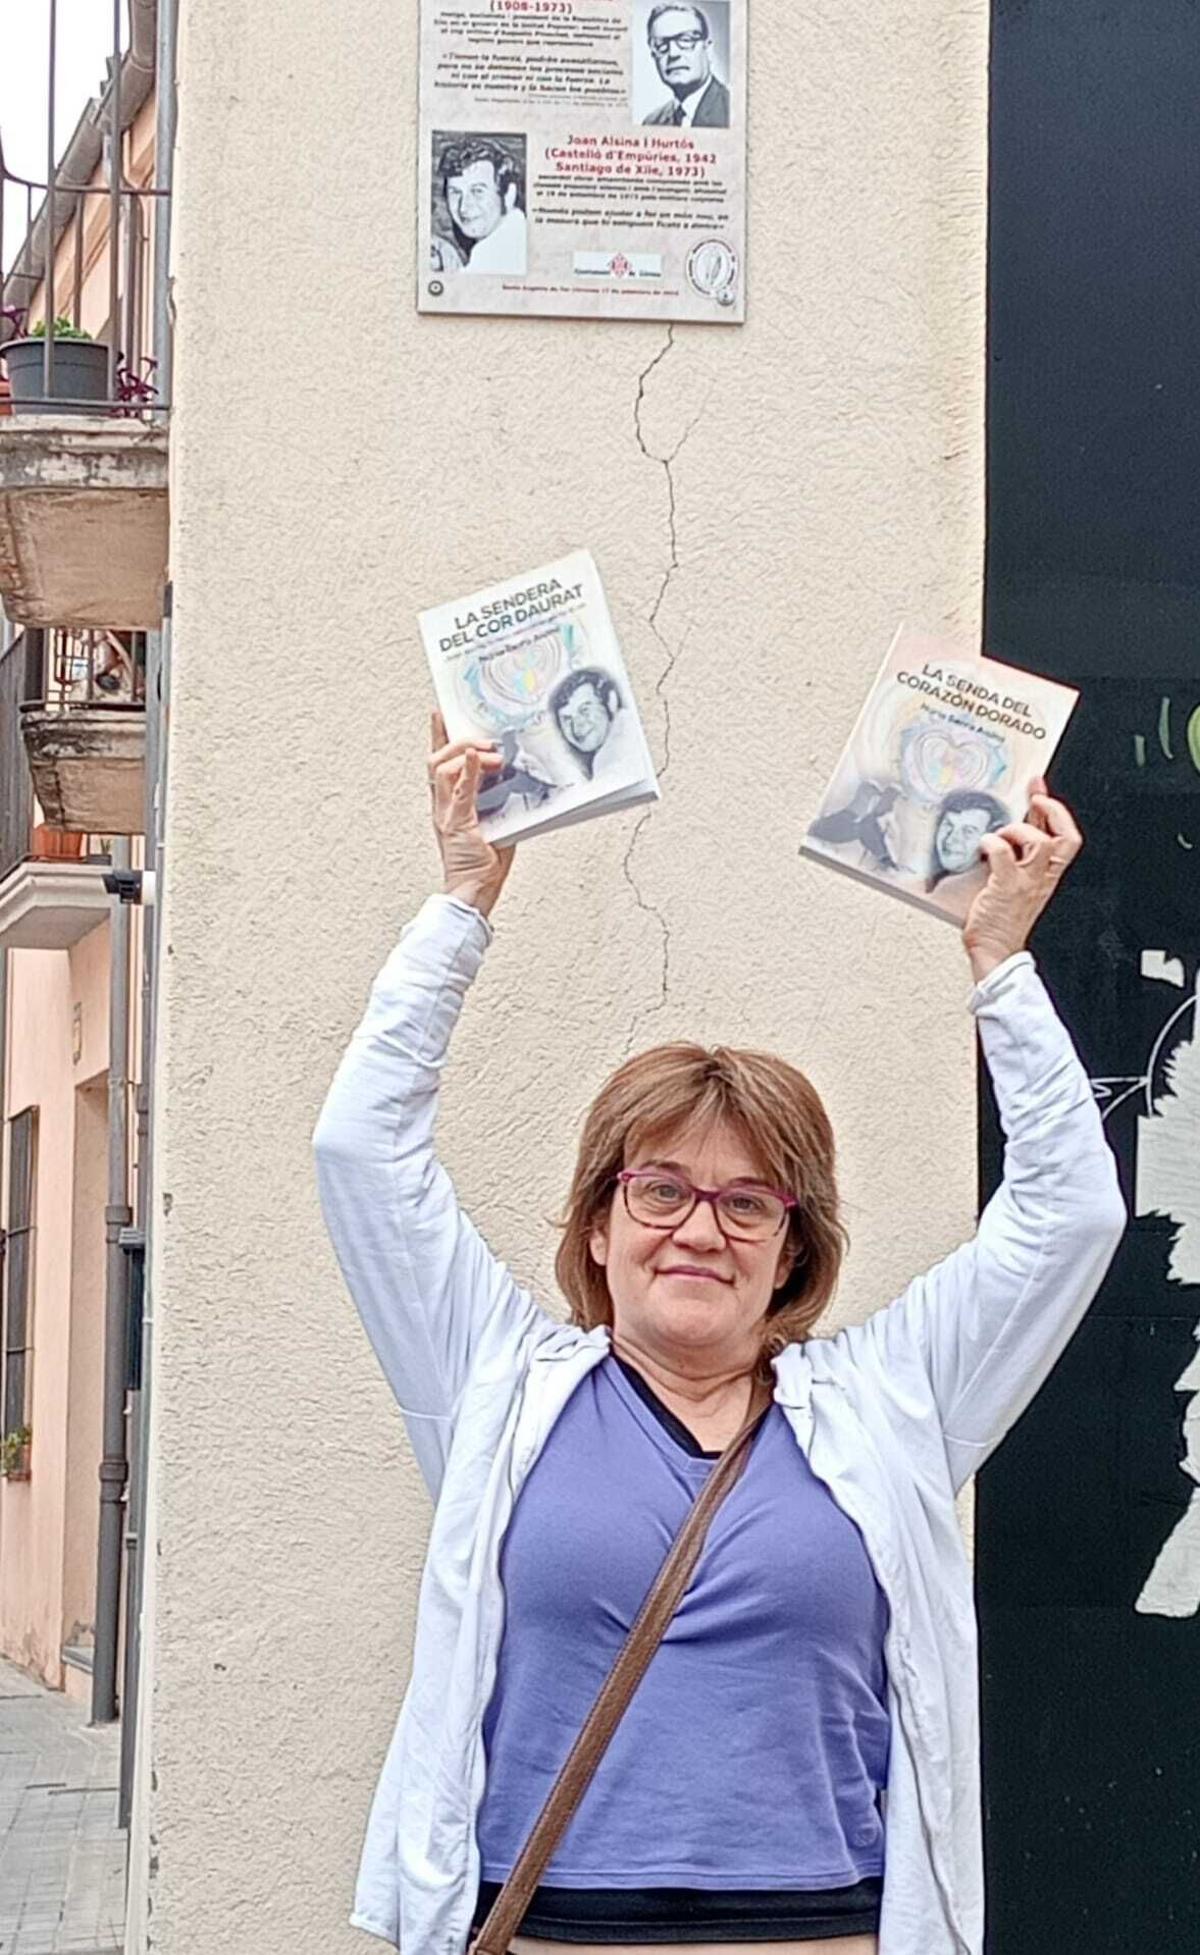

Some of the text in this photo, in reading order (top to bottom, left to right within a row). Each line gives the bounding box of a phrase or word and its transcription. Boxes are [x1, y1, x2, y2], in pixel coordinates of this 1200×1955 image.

[567, 135, 597, 147] Joan
[601, 136, 640, 148] Alsina
[651, 136, 695, 149] Hurtós
[685, 152, 716, 164] 1942
[556, 162, 612, 175] Santiago
[616, 163, 631, 174] de
[667, 165, 706, 179] 1973)
[439, 631, 474, 652] DEL
[476, 614, 514, 638] COR
[515, 583, 583, 623] DAURAT
[454, 578, 563, 630] LA SENDERA
[896, 671, 974, 714] CORAZÓN
[975, 704, 1047, 740] DORADO
[922, 663, 1032, 718] LA SENDA DEL
